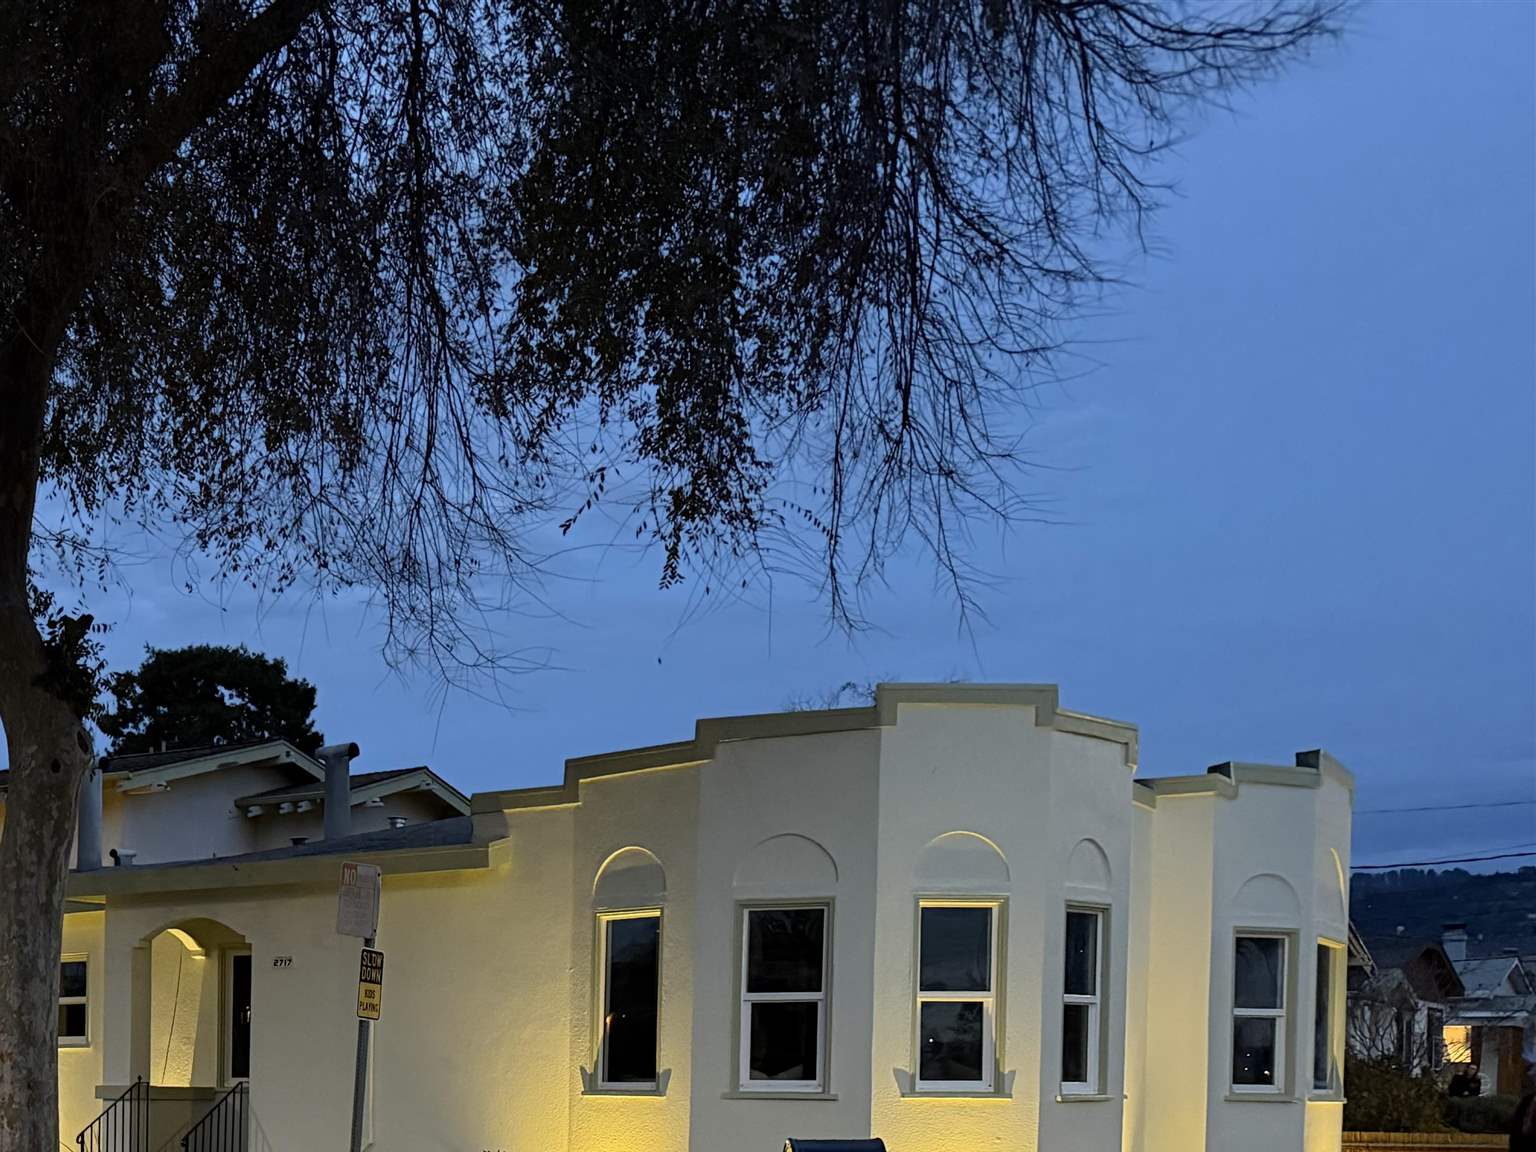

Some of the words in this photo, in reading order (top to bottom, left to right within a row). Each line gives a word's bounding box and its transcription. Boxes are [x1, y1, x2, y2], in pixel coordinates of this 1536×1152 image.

[344, 868, 356, 885] NO
[273, 959, 292, 967] 2717
[362, 951, 383, 967] SLOW
[361, 966, 382, 984] DOWN
[364, 988, 376, 999] KIDS
[359, 1000, 378, 1013] PLAYING
